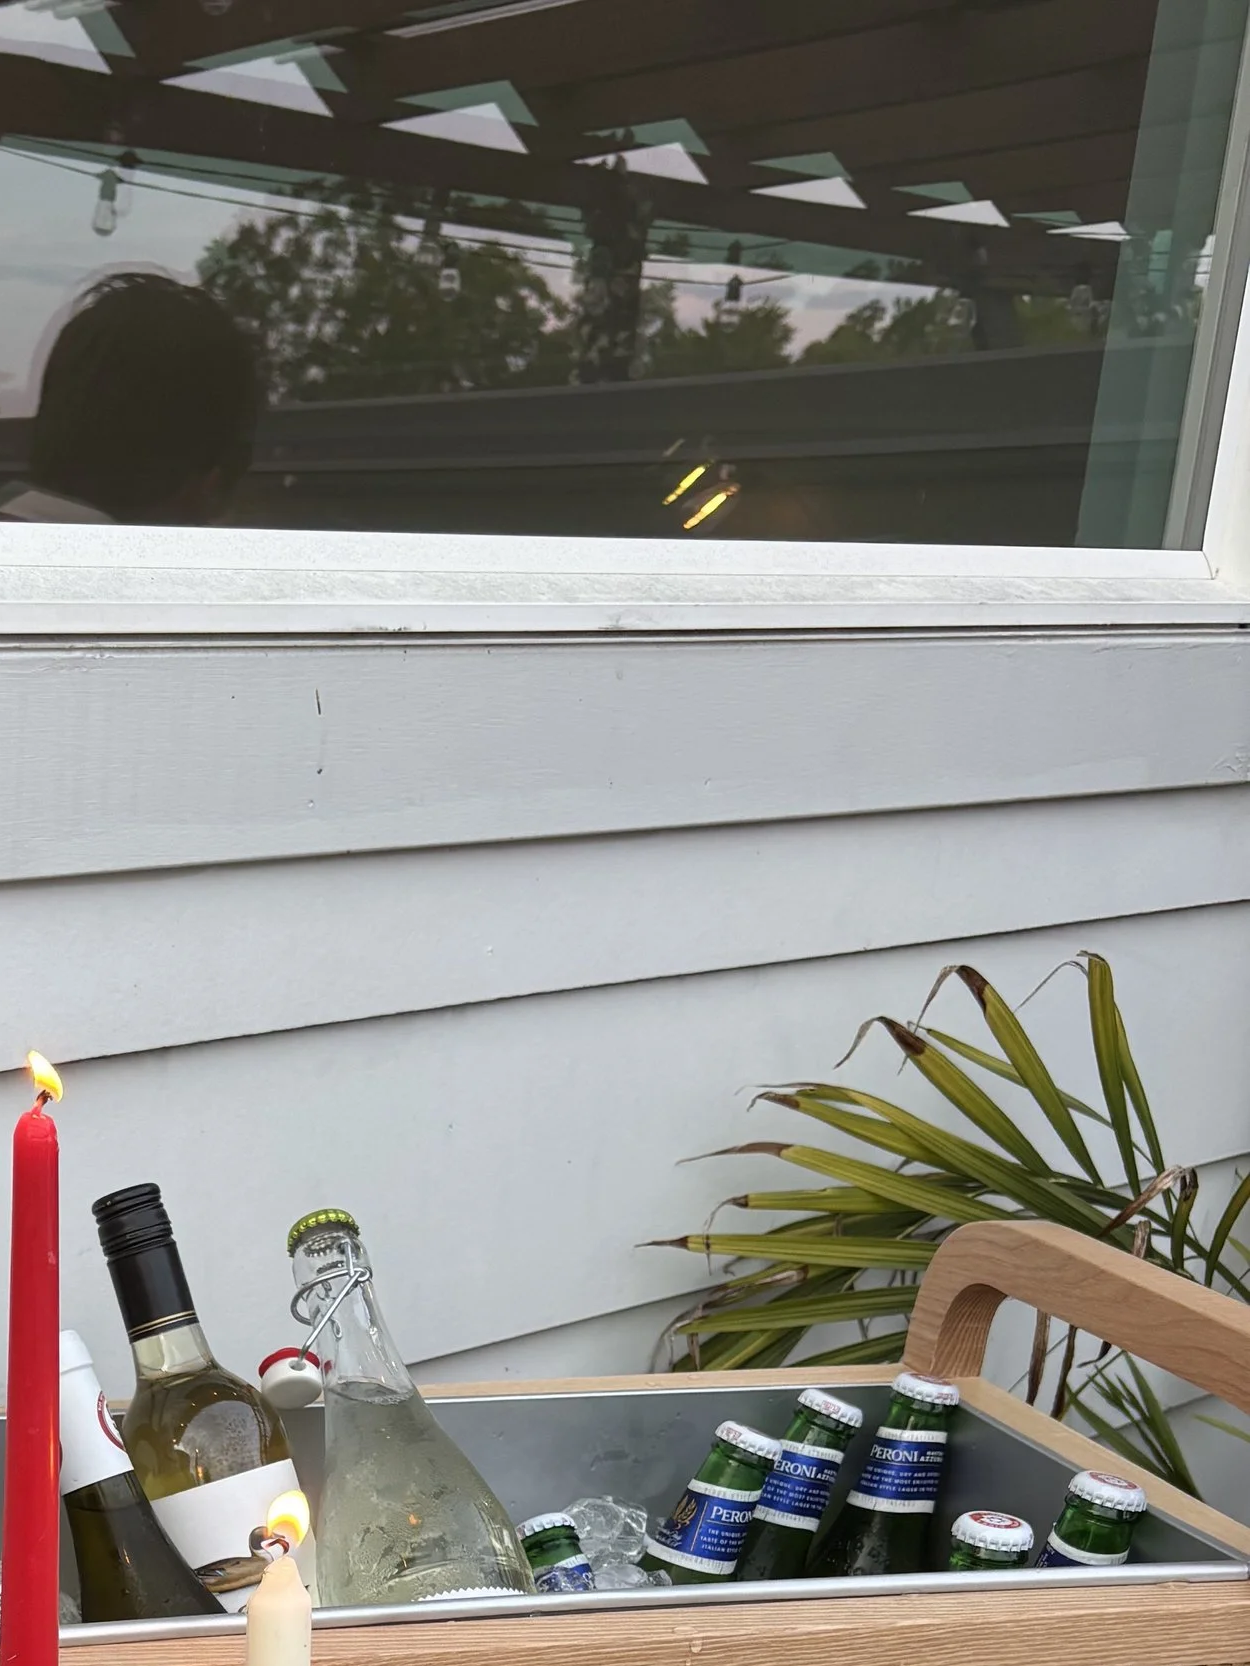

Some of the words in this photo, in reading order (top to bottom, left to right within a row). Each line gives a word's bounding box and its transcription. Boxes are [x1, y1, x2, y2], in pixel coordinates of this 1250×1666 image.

[870, 1444, 919, 1462] PERONI
[773, 1460, 817, 1478] ERONI
[710, 1506, 753, 1523] PERON
